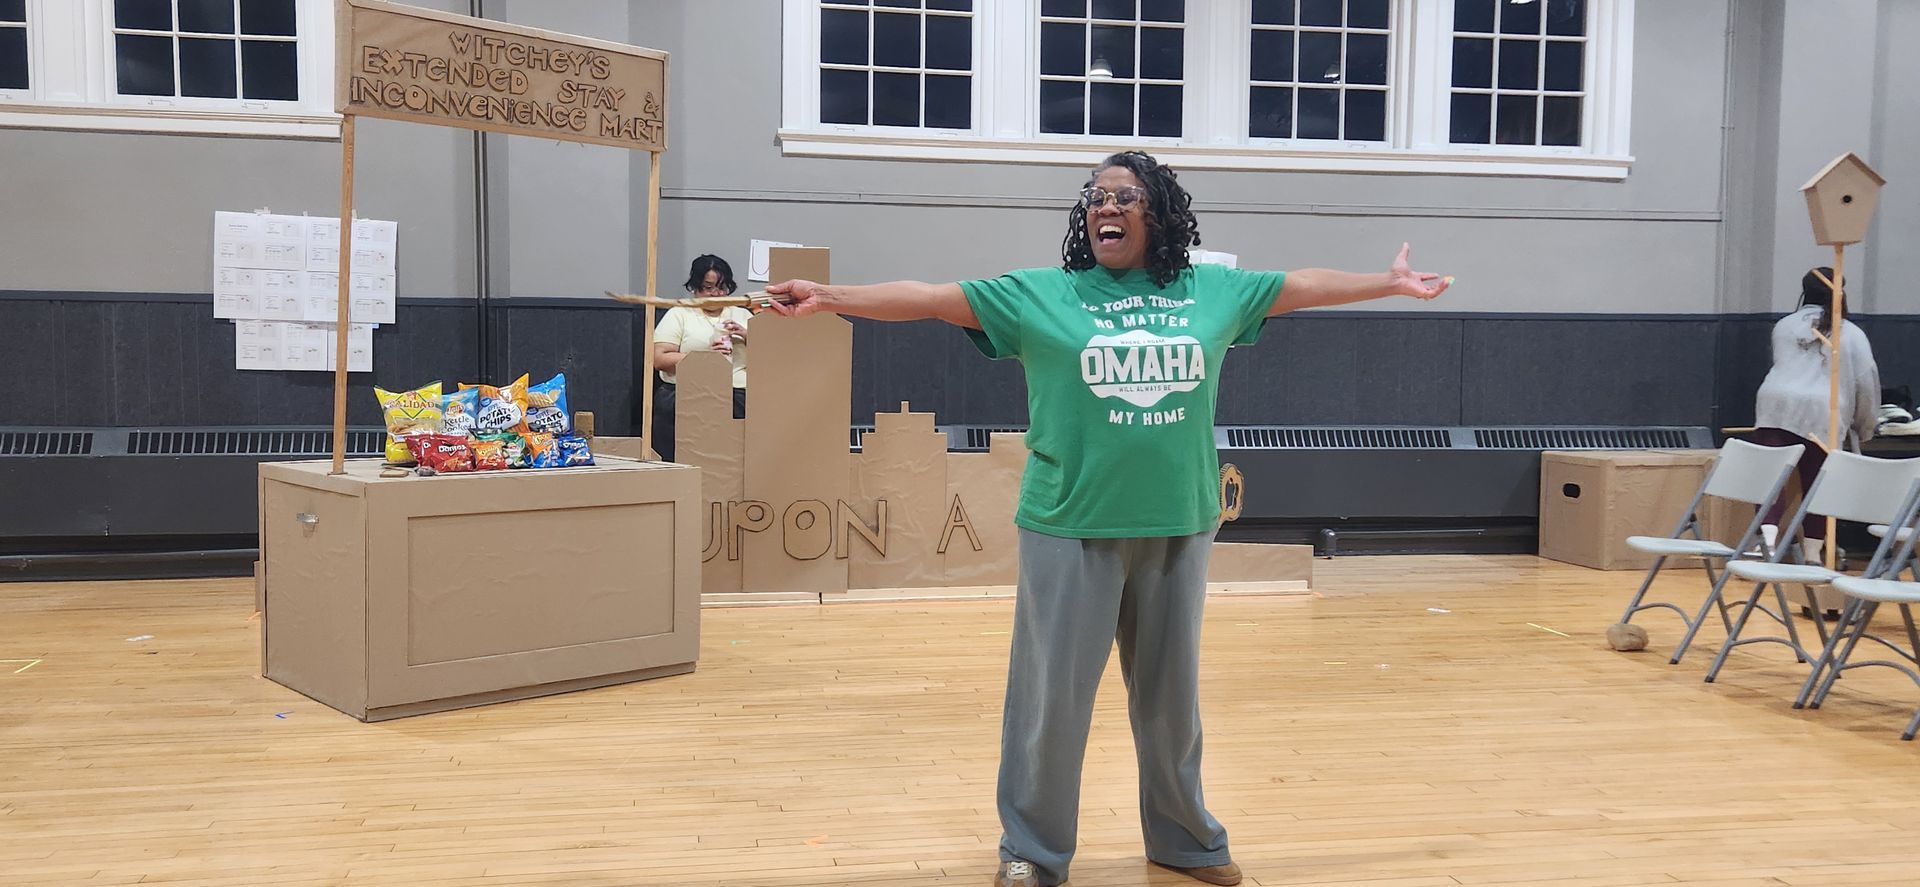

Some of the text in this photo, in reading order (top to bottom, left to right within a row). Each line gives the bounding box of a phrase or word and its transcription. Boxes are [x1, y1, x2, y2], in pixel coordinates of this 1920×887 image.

[557, 80, 625, 112] STAY
[644, 91, 660, 117] &
[600, 113, 663, 143] MART
[1103, 295, 1145, 313] YOUR
[1094, 313, 1189, 329] NO MATTER
[1080, 344, 1206, 385] OMAHA
[1136, 384, 1162, 392] ALWAYS
[444, 416, 470, 428] Kettle
[485, 414, 512, 428] CHIPS
[531, 411, 563, 426] OTATO
[1109, 407, 1186, 426] MY HOME
[937, 493, 983, 554] A
